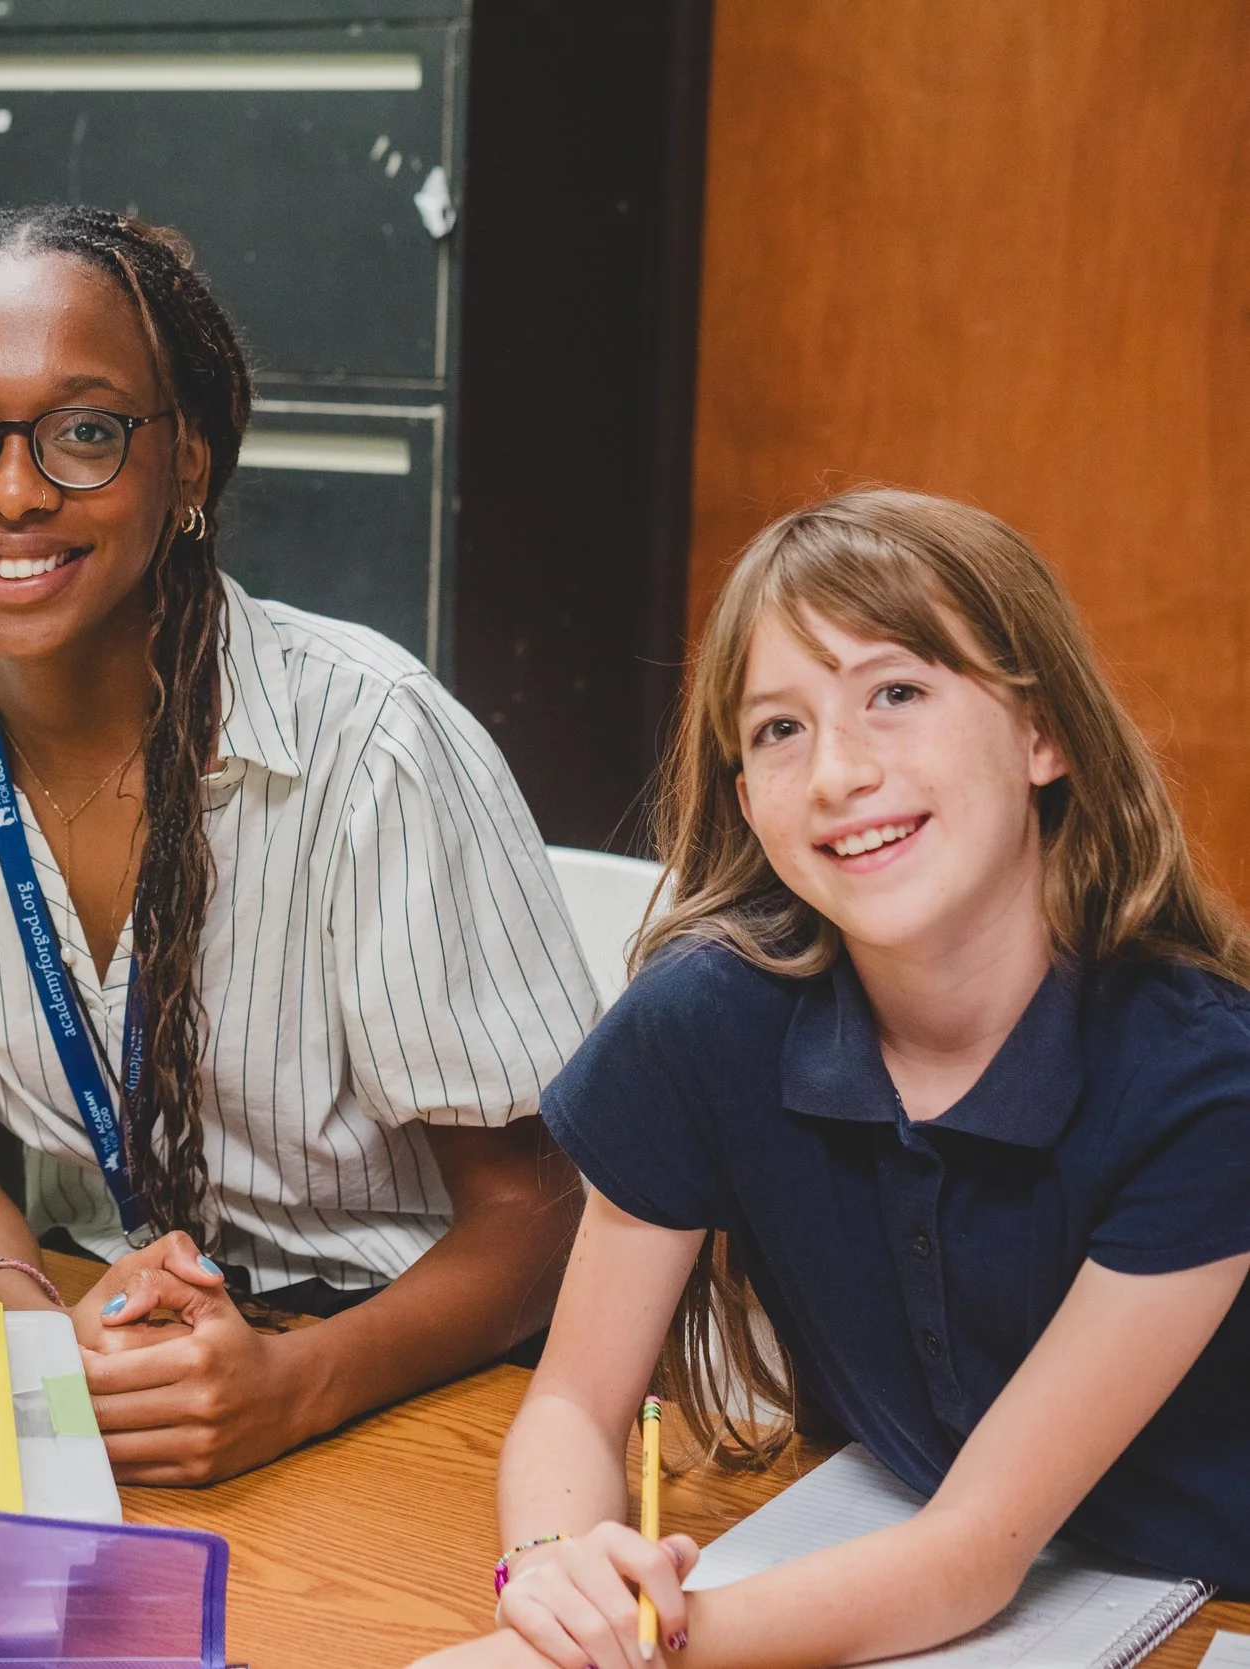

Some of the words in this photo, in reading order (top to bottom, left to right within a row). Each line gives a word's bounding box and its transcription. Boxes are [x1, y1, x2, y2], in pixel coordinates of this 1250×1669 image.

[17, 880, 77, 1038] academyforgod.org
[83, 1090, 107, 1134] ACADEMY
[100, 1107, 113, 1129] GOD
[100, 1136, 112, 1154] THE
